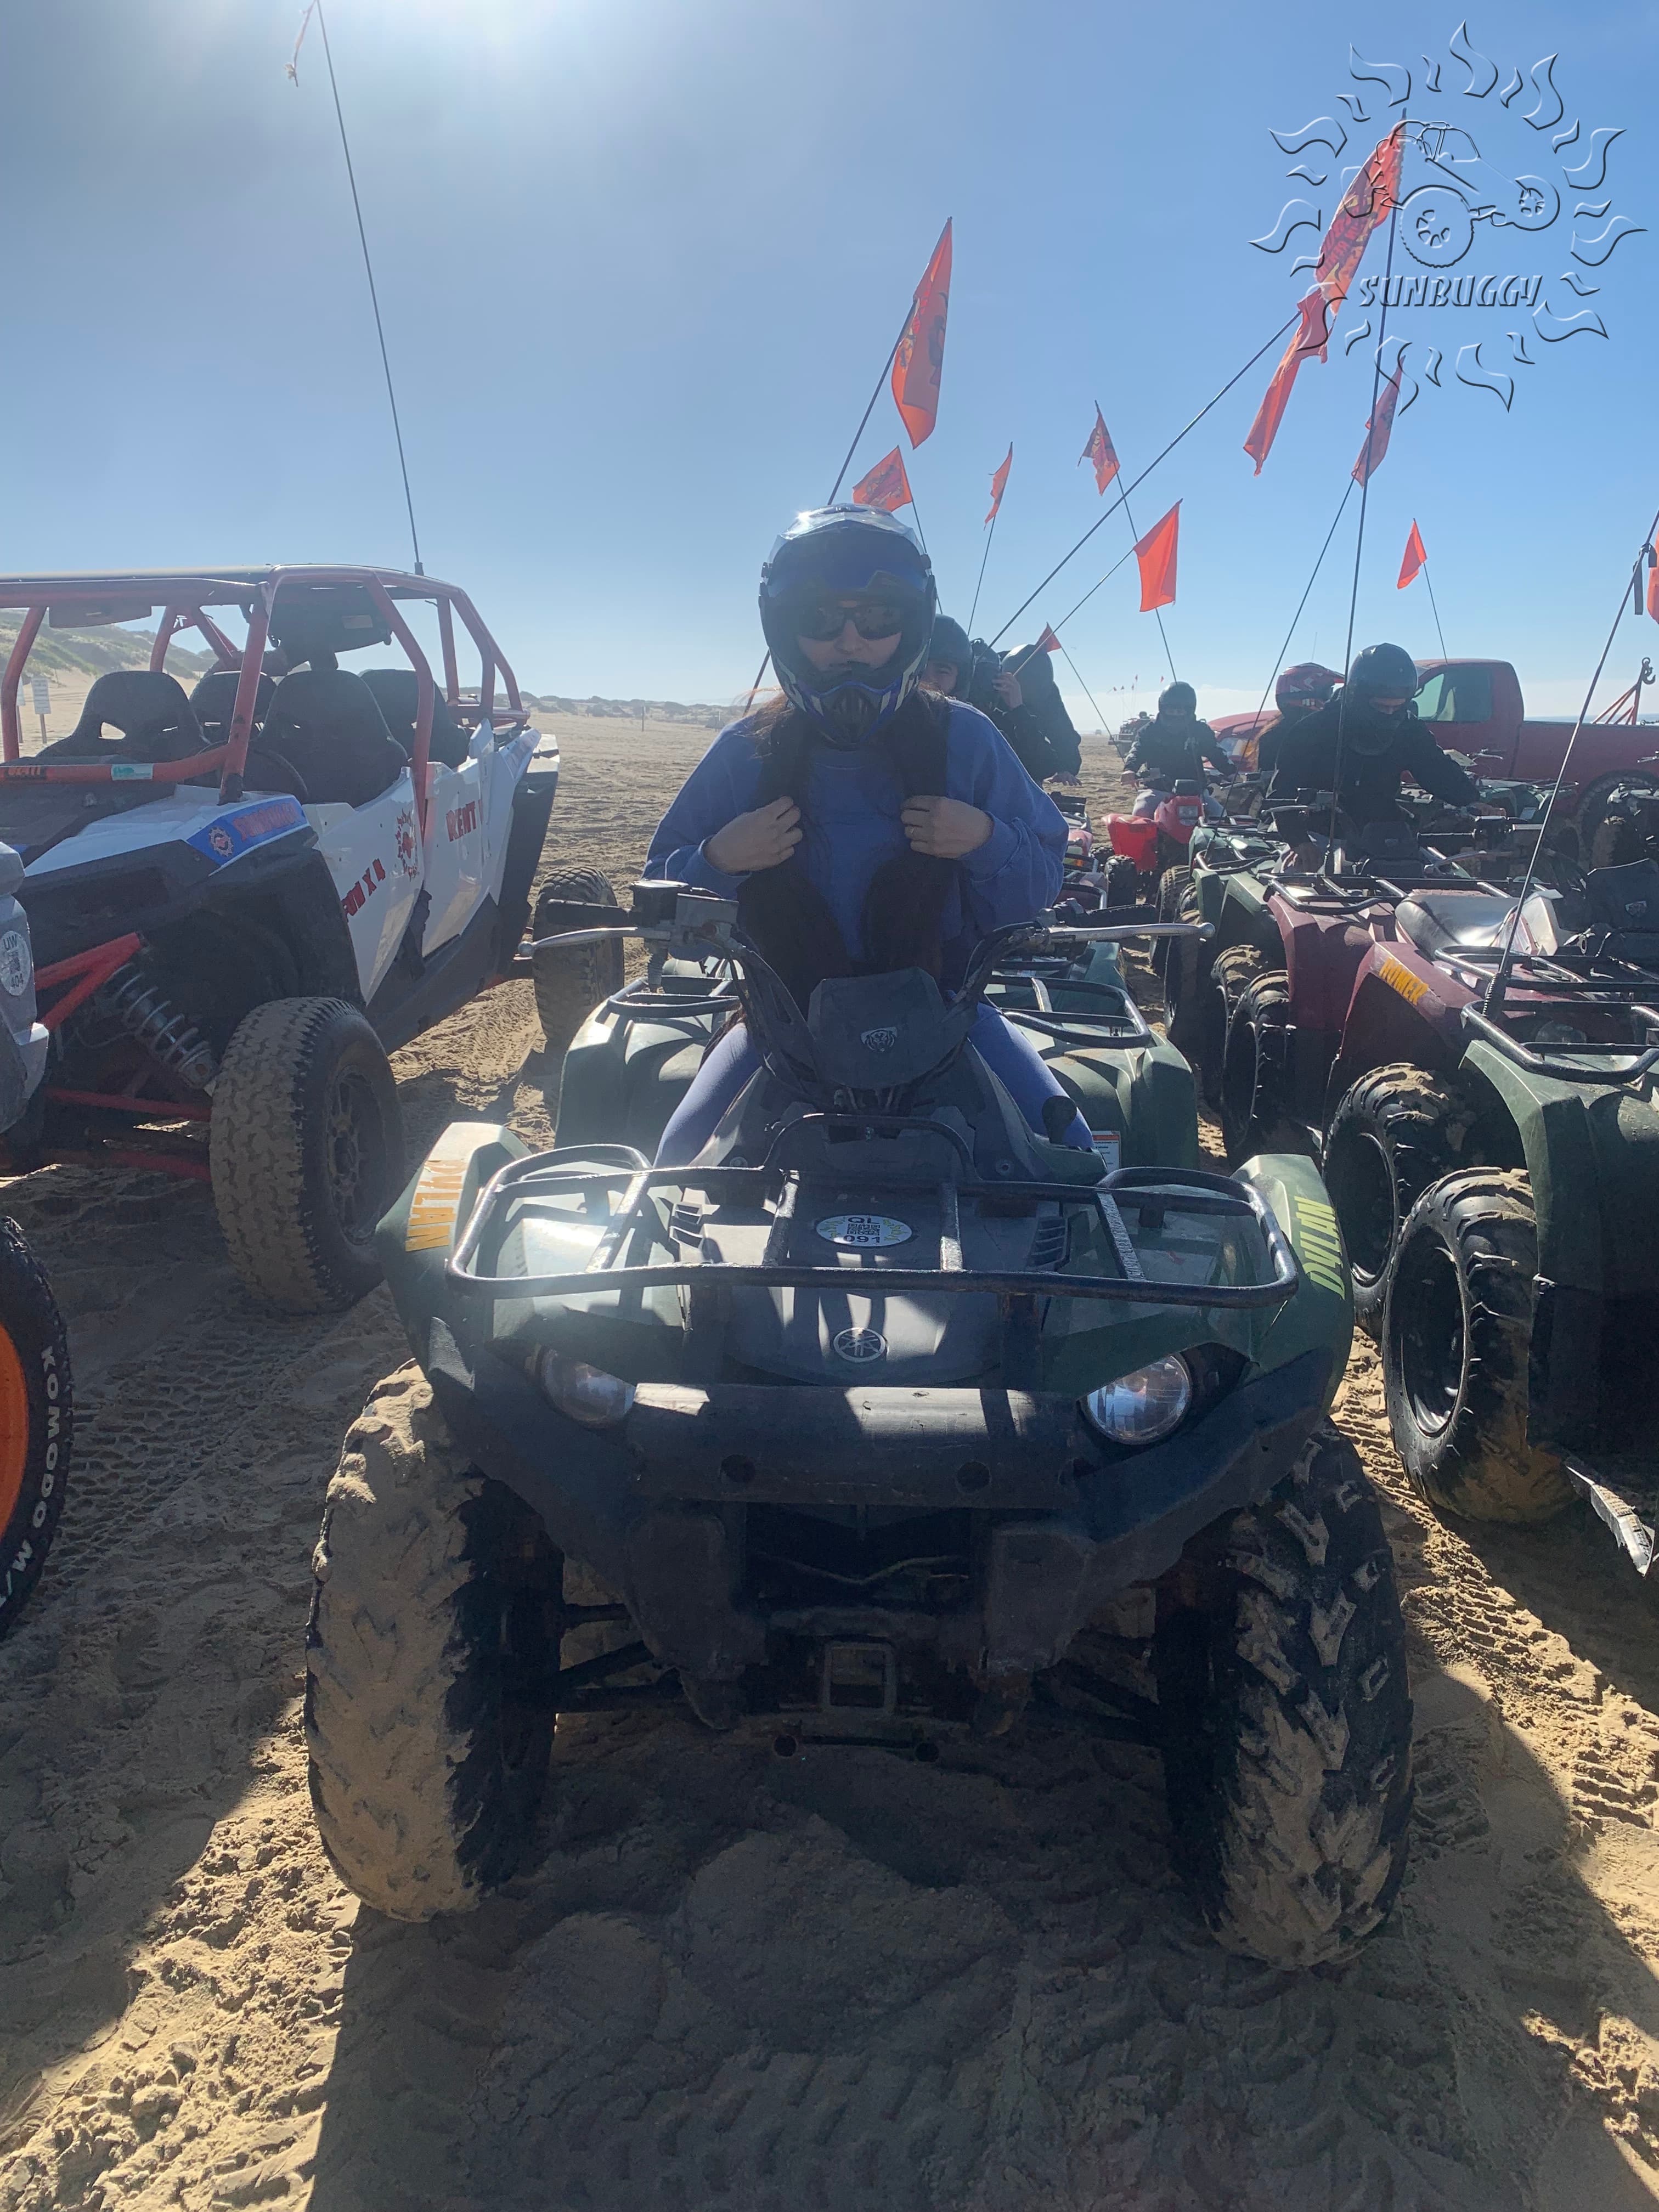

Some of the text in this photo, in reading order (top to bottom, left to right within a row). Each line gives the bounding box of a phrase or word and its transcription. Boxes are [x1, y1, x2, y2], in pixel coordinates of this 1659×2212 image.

[446, 801, 477, 842] RENT
[1378, 957, 1429, 1006] HOMER
[405, 1160, 467, 1252] DYLAN
[843, 1235, 880, 1243] 091
[1294, 1195, 1345, 1300] DYLAN
[33, 1346, 60, 1528] KOMODO
